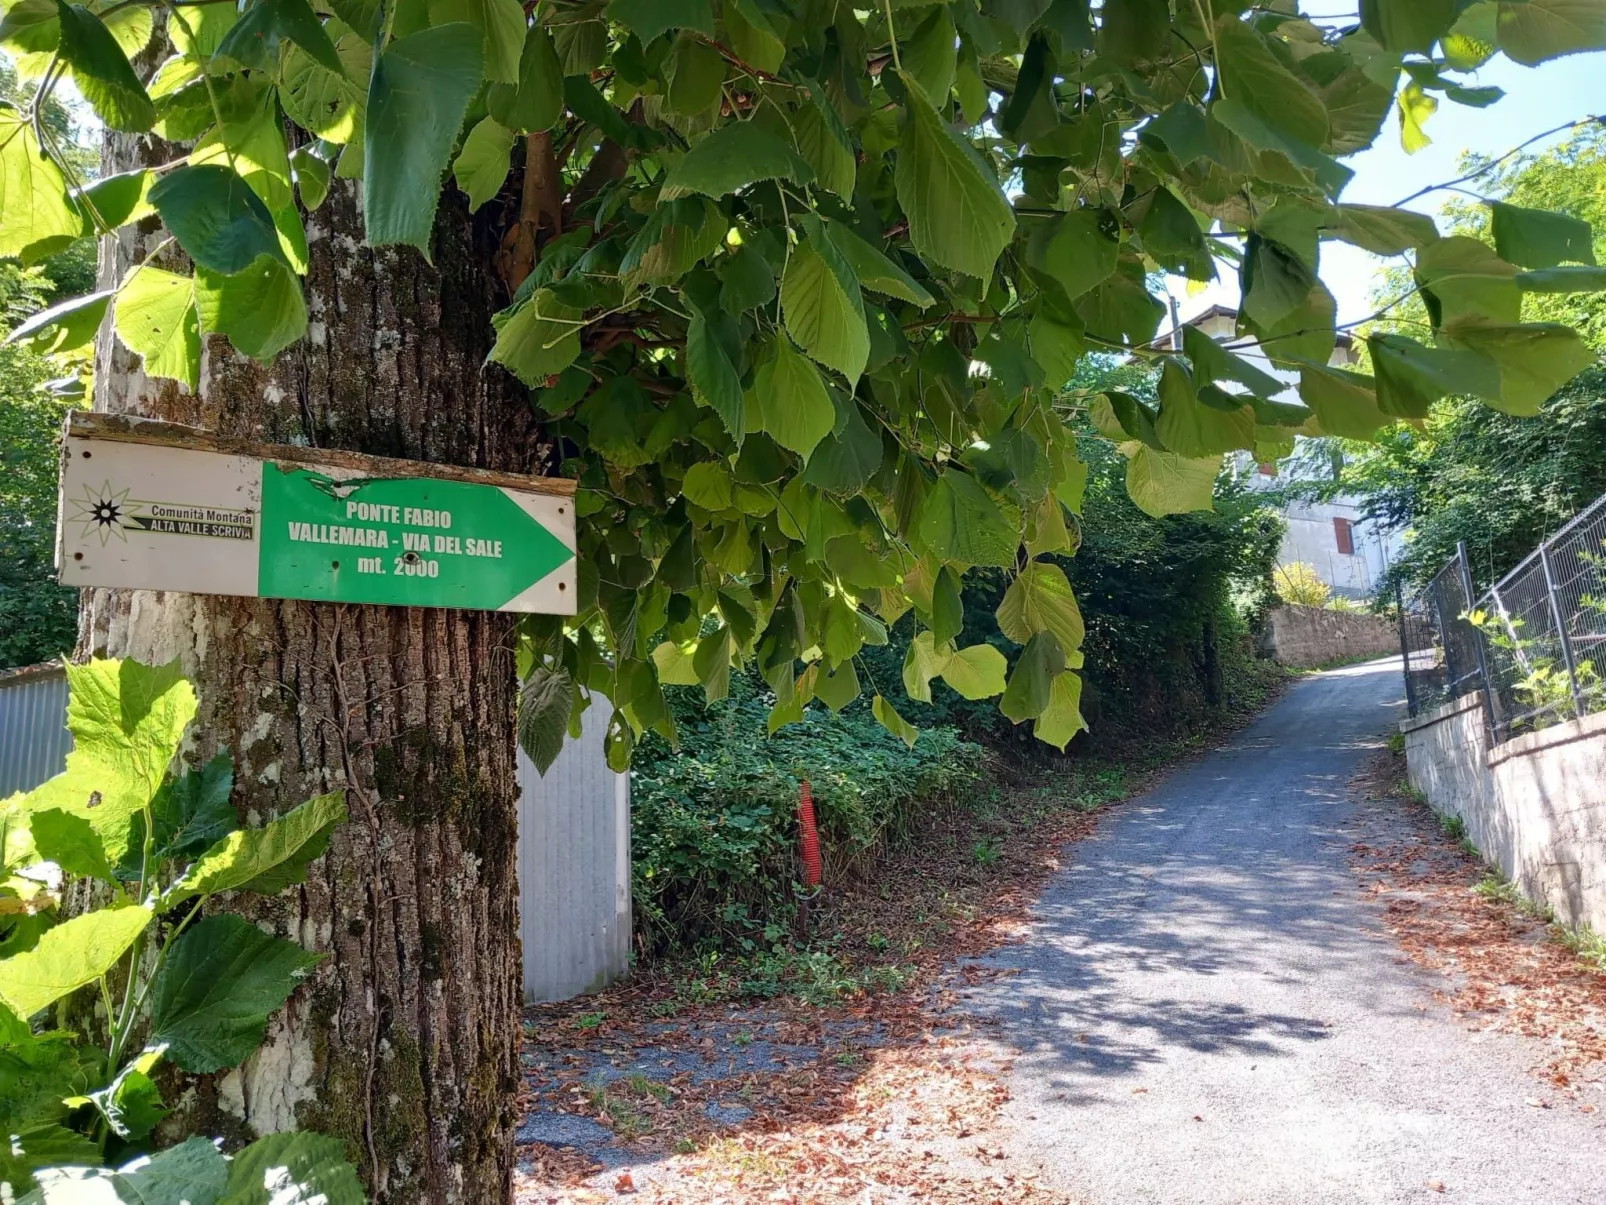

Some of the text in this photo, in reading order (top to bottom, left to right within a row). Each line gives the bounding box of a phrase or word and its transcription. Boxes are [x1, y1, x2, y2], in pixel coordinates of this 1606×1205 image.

[152, 505, 252, 525] Comunità Montana
[347, 501, 452, 529] PONTE FABIO
[151, 520, 251, 538] ALTA VALLE SCRIVIA
[288, 521, 389, 549] VALLEMARA
[402, 532, 431, 552] VIA
[434, 535, 462, 555] DEL
[466, 538, 503, 558] SALE
[357, 557, 439, 577] mt. 2000
